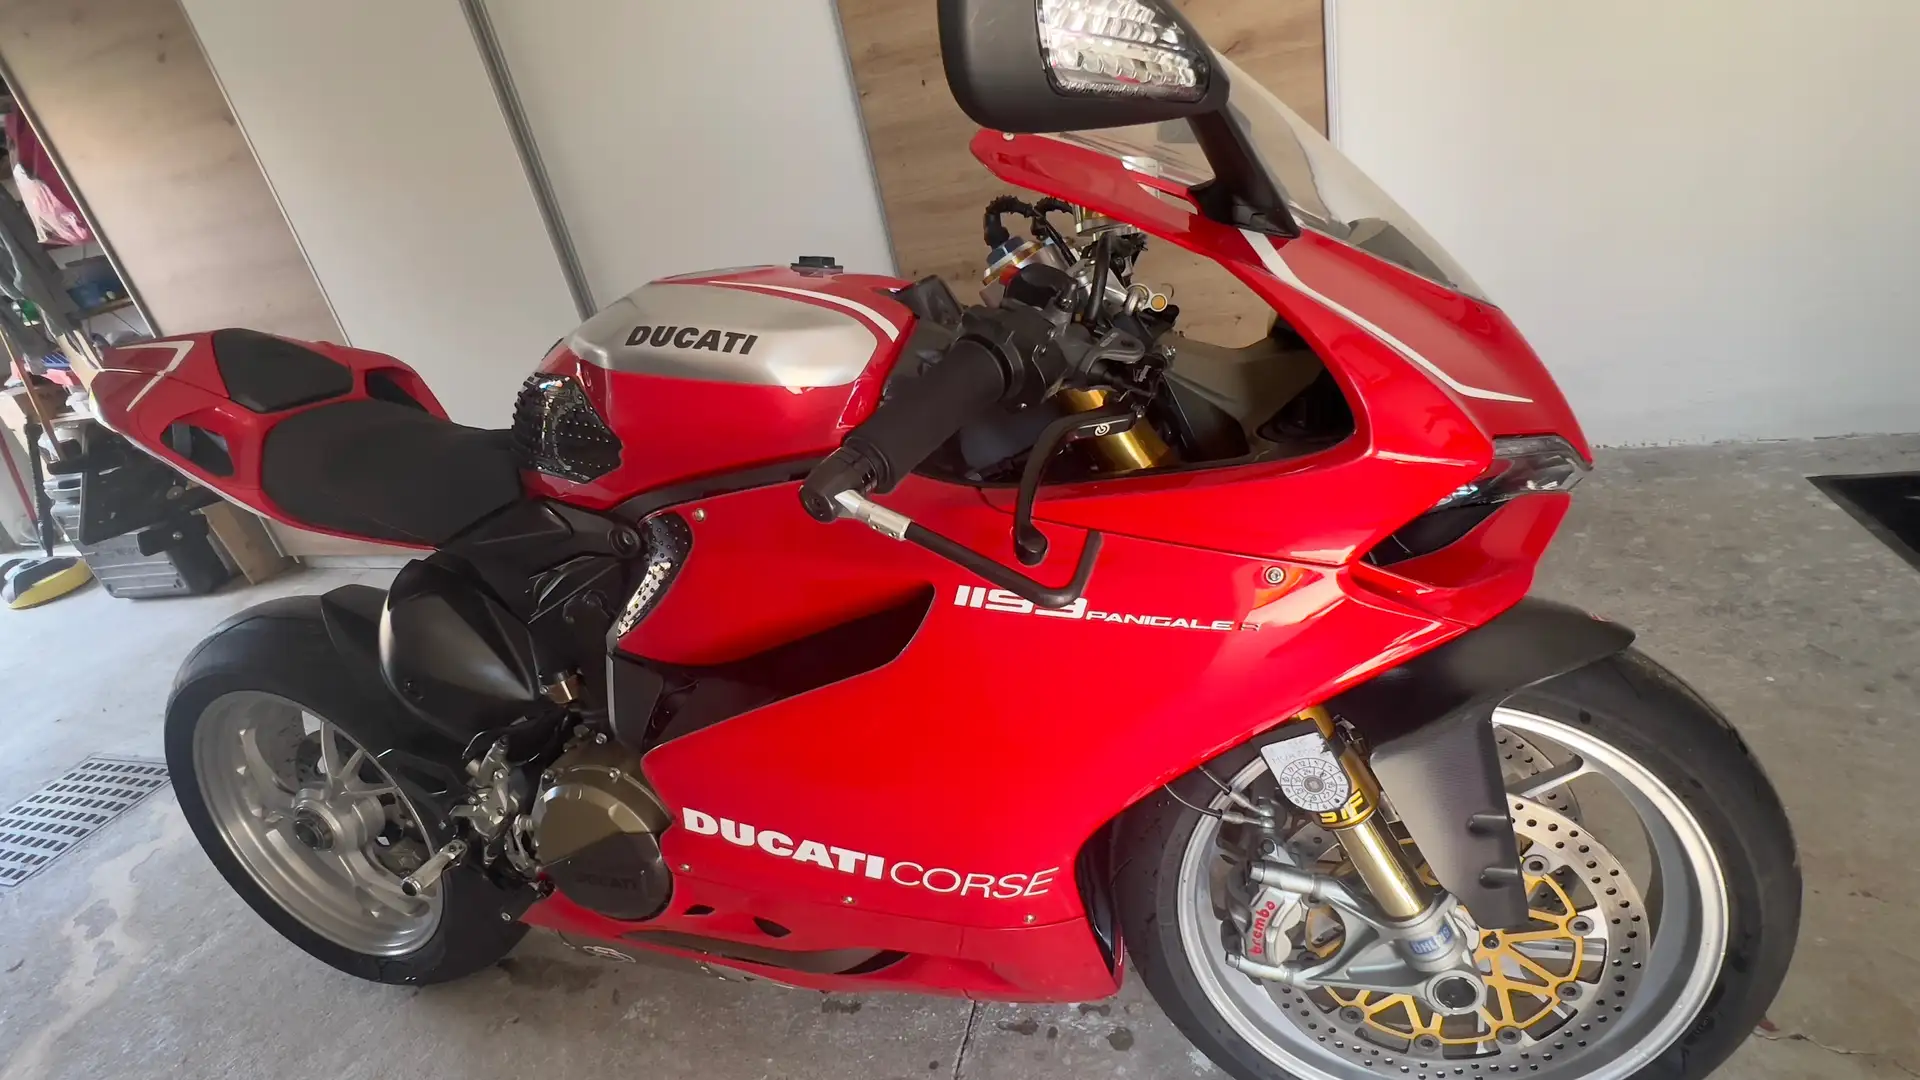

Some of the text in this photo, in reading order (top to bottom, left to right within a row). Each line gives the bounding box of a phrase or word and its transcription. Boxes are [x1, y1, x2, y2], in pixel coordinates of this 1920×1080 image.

[625, 325, 758, 355] DUCATI
[1085, 611, 1234, 632] PANIGALE
[682, 807, 1059, 900] DUCATI CORSE
[1248, 900, 1276, 956] brembo
